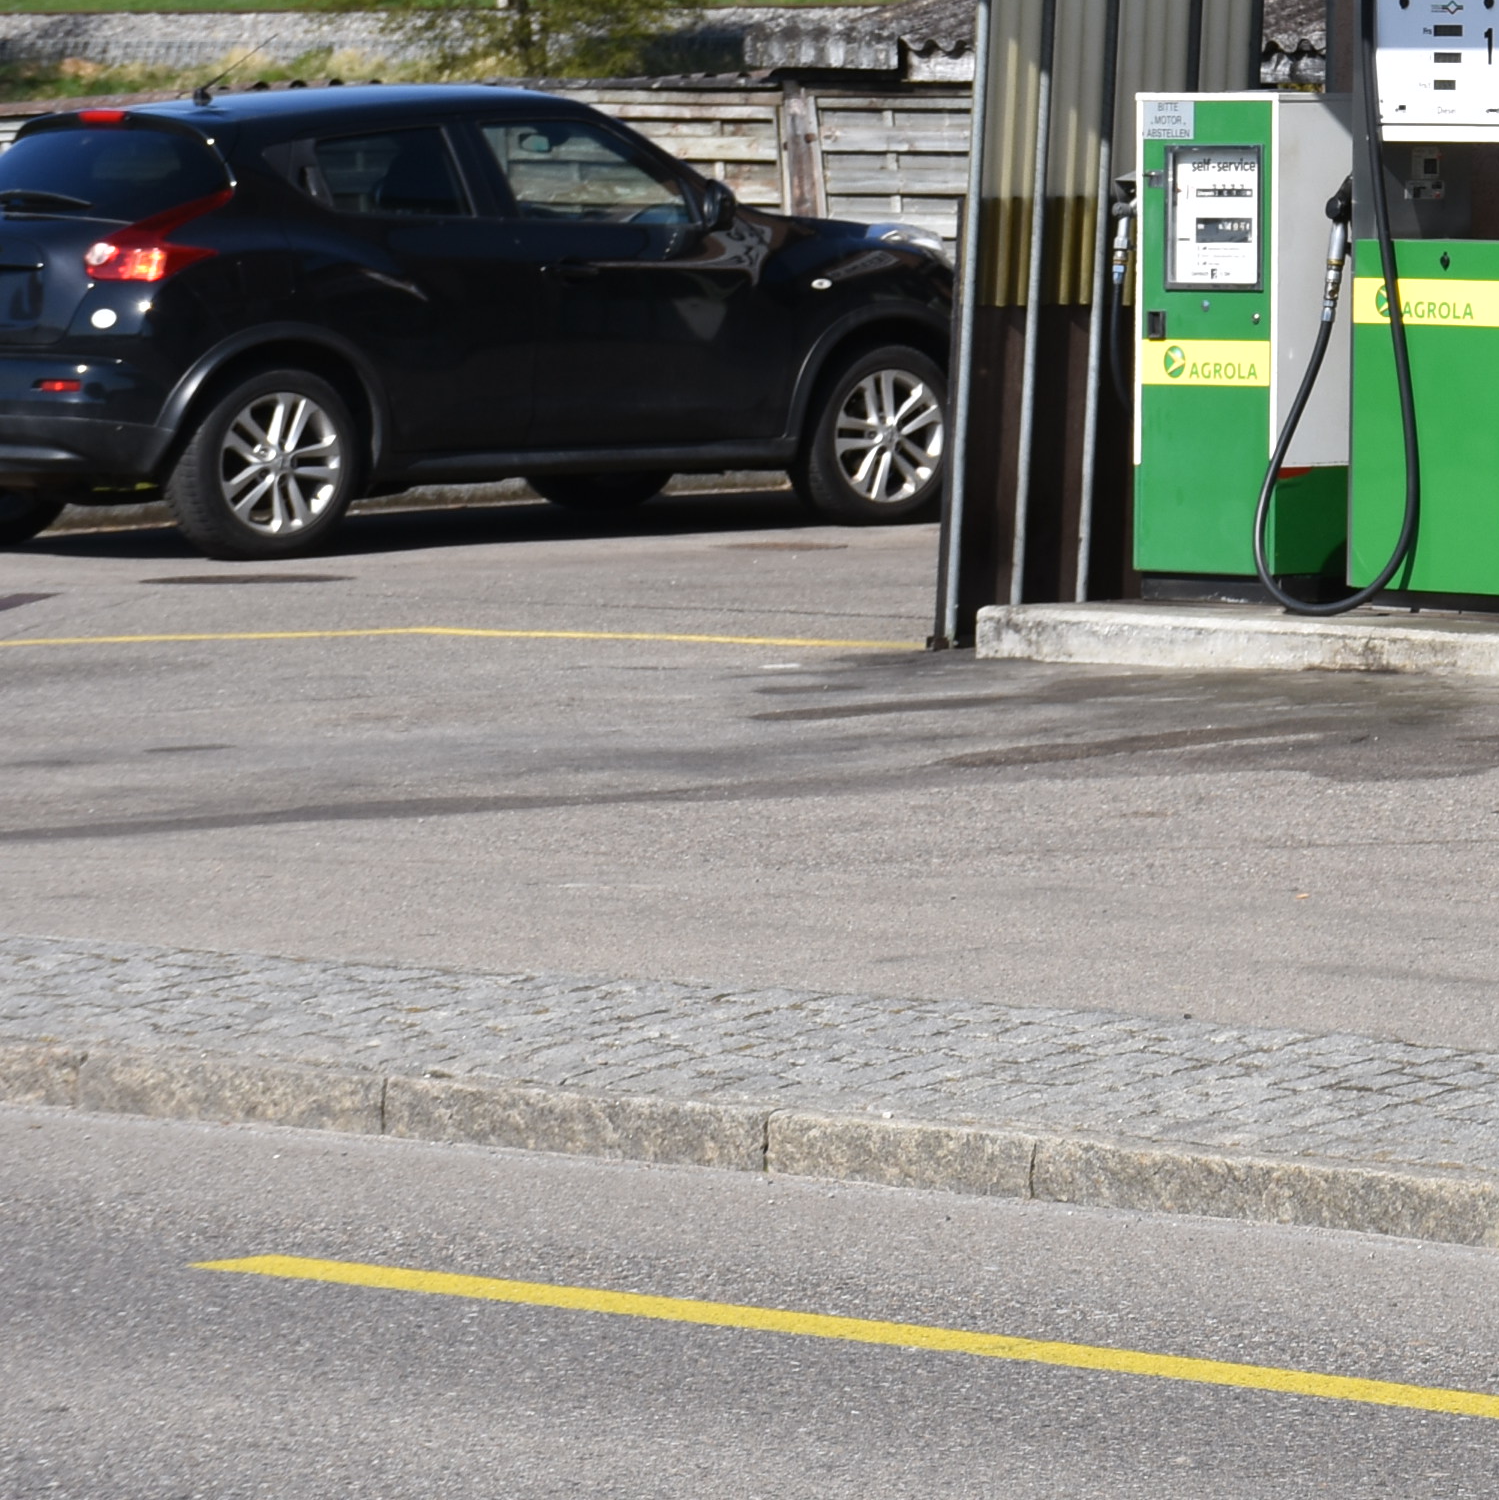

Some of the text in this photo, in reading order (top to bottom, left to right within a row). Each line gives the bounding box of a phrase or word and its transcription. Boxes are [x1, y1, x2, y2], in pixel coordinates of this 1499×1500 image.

[1483, 27, 1493, 65] 1
[1157, 102, 1179, 112] BITTE
[1154, 115, 1182, 125] MOTOR
[1146, 128, 1190, 138] ABSTELLEN
[1191, 158, 1256, 172] self-service
[1402, 301, 1474, 320] AGROLA
[1188, 362, 1258, 380] AGROLA
